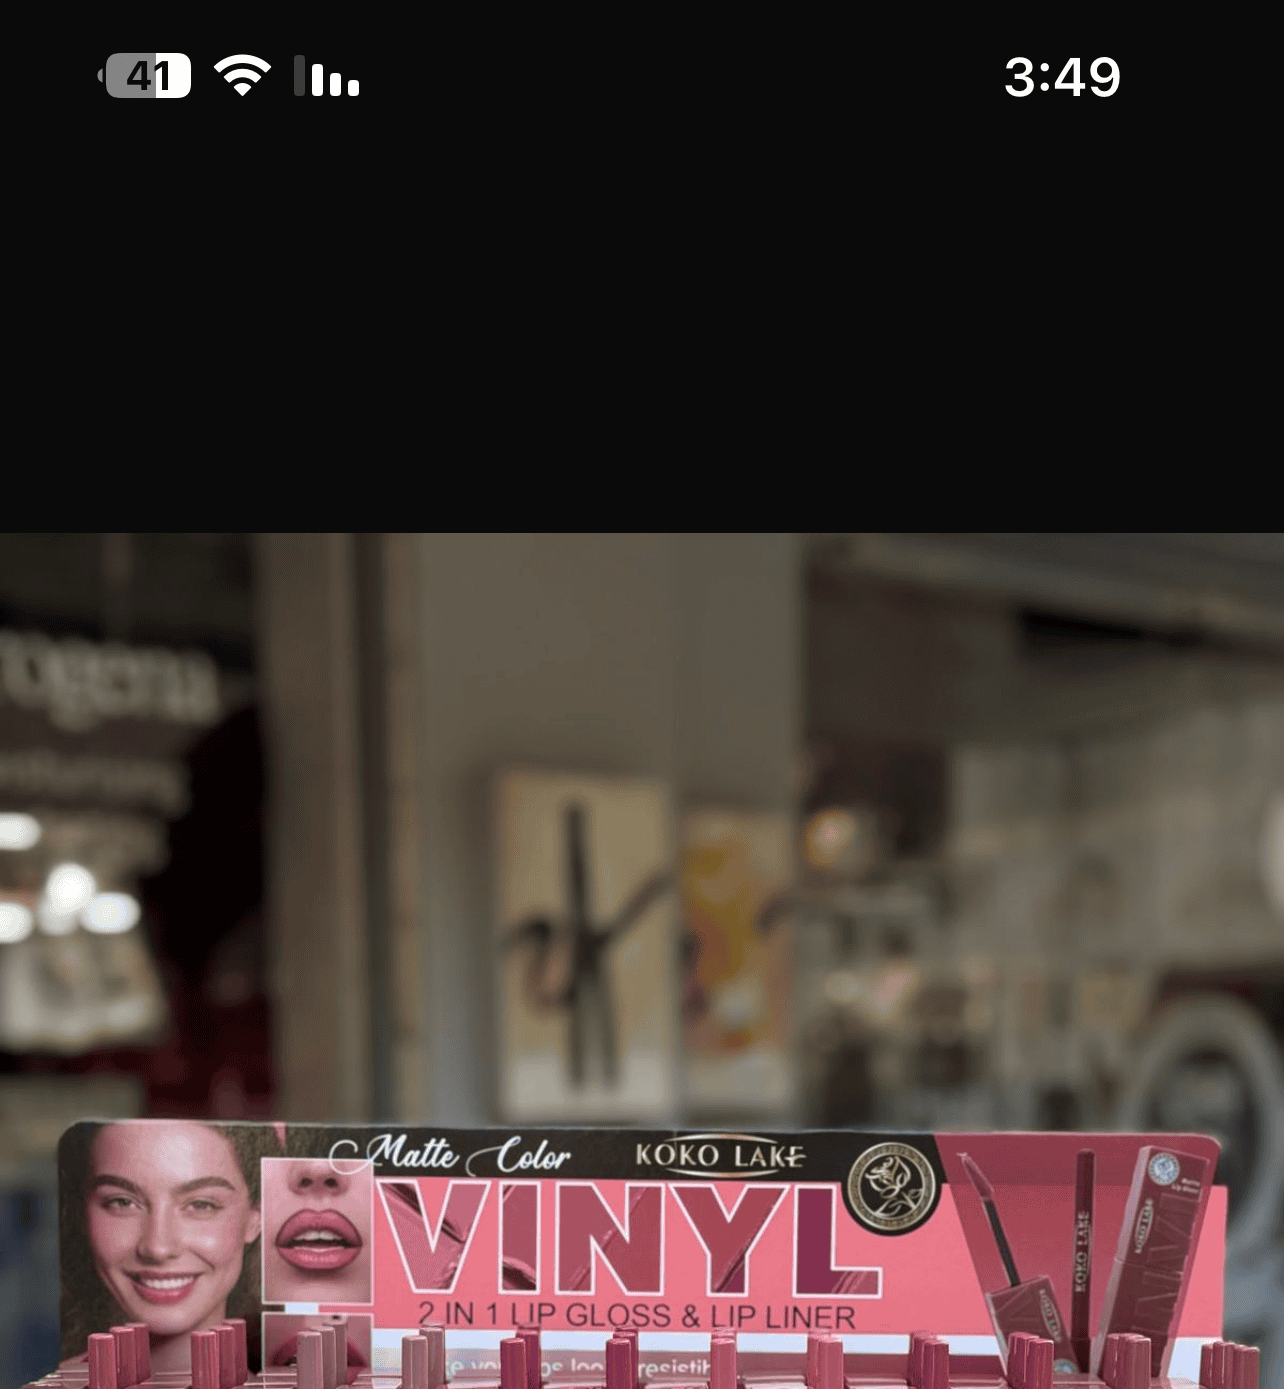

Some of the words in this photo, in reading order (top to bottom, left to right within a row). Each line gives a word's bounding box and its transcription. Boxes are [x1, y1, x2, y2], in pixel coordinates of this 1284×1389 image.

[329, 1133, 460, 1175] Matte
[465, 1135, 571, 1177] Color
[636, 1143, 720, 1166] KOKO
[735, 1145, 807, 1168] LAKE
[375, 1179, 883, 1299] VINYL
[1077, 1211, 1089, 1246] LAKE
[1075, 1251, 1088, 1293] KOKO
[419, 1301, 435, 1325] 2
[446, 1302, 474, 1325] IN
[487, 1302, 497, 1325] 1
[512, 1302, 556, 1326] LIP
[566, 1302, 671, 1328] GLOSS
[682, 1304, 700, 1328] &
[711, 1304, 756, 1328] LIP
[766, 1305, 856, 1329] LINER
